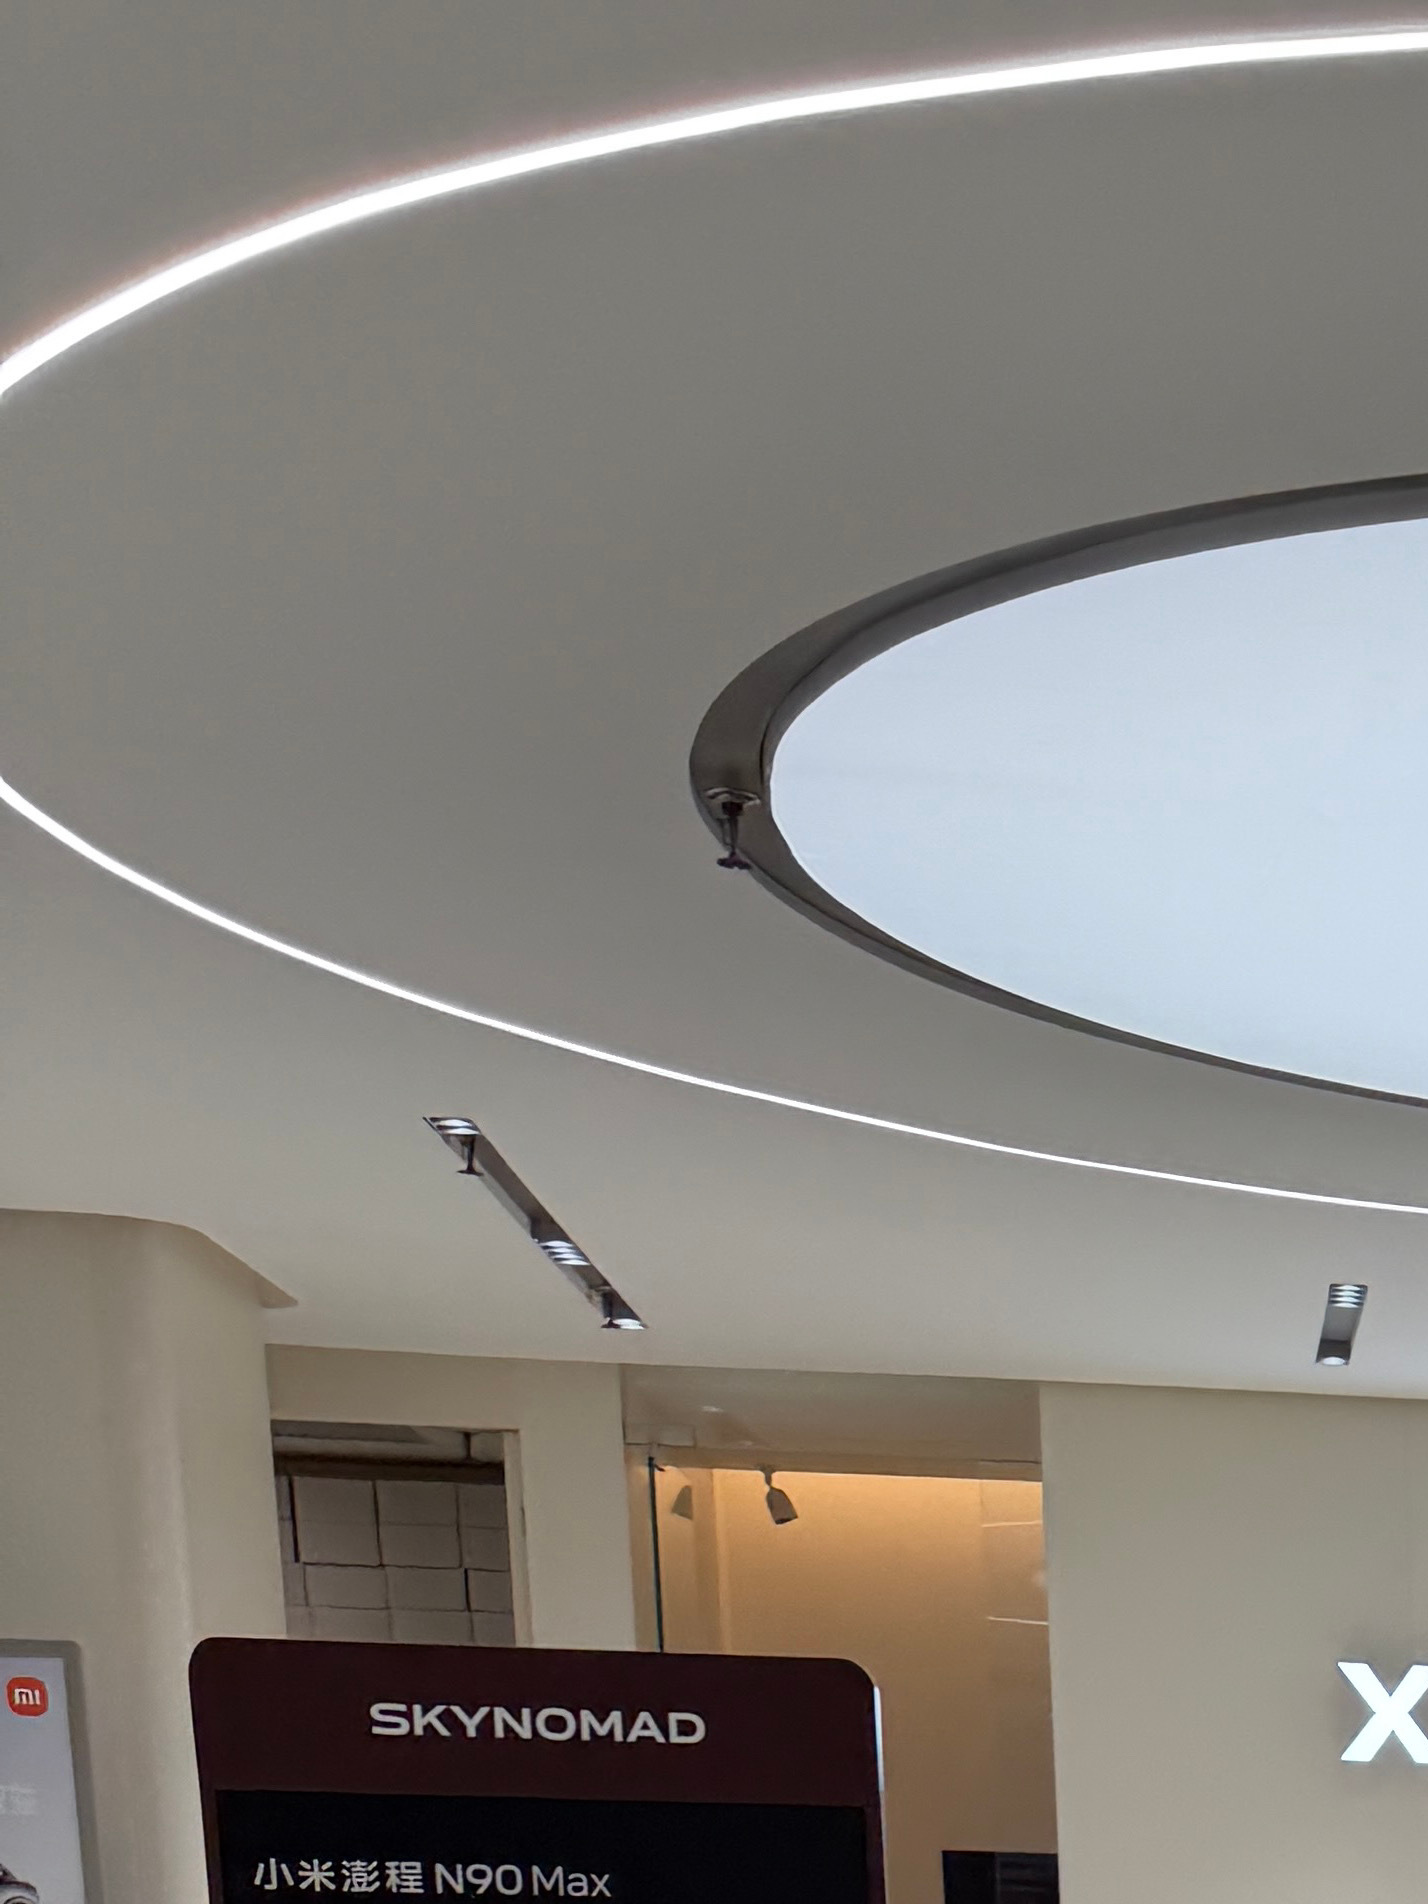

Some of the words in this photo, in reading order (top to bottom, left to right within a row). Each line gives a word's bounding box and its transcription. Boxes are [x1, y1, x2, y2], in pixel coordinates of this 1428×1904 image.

[369, 1702, 706, 1744] SKYNOMAD
[254, 1858, 425, 1894] 小米澎程
[435, 1863, 523, 1896] N90
[532, 1865, 612, 1898] Max
